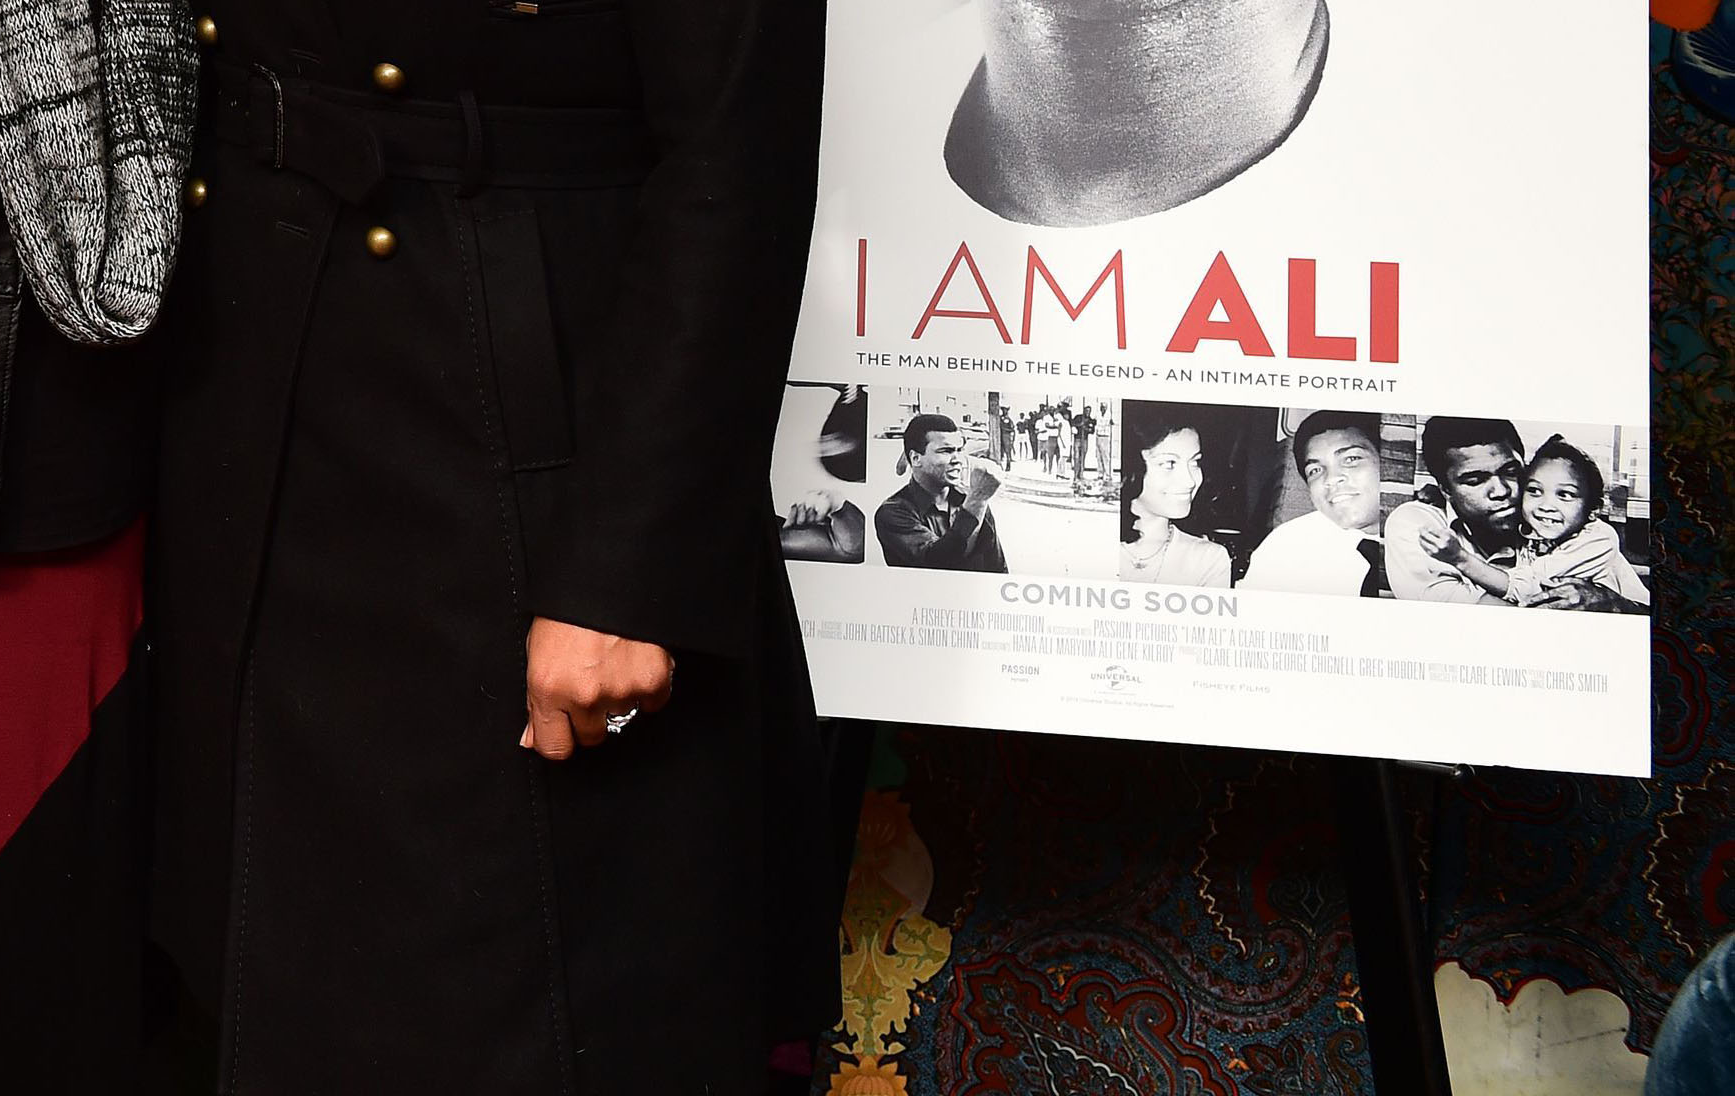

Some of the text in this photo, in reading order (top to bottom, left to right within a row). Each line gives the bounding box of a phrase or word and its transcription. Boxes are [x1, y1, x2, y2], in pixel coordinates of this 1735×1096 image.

[856, 238, 1399, 363] I AM ALI
[856, 352, 893, 368] THE
[898, 354, 940, 371] MAN
[947, 357, 1018, 375] BEHIND
[1025, 360, 1061, 377] THE
[1068, 363, 1145, 380] LEGEND
[1166, 367, 1193, 382] AN
[1200, 369, 1291, 388] INTIMATE
[1298, 375, 1399, 393] PORTRAIT
[1000, 581, 1238, 618] COMING SOON
[912, 607, 919, 625] A
[920, 607, 955, 629] FISHEYE
[958, 610, 985, 630] FILMS
[988, 611, 1044, 634] PRODUCTION
[1094, 618, 1131, 641] PASSION
[1135, 621, 1178, 643] PICTURES
[1190, 626, 1206, 645] AM
[1229, 629, 1236, 646] A
[1238, 629, 1266, 650] CLARE
[1269, 631, 1304, 652] LEWINS
[1307, 634, 1329, 653] FILM
[843, 622, 867, 642] JOHN
[870, 624, 906, 645] BATTSEK
[909, 628, 915, 644] &
[918, 627, 948, 647] SIMON
[951, 630, 979, 649] CHINN
[1012, 634, 1037, 654] HANA
[1038, 636, 1052, 655] ALI
[1056, 638, 1096, 658] MARYUM
[1098, 641, 1113, 659] ALI
[1115, 642, 1138, 661] GENE
[1142, 643, 1175, 664] KILROY
[1203, 647, 1230, 668] CLARE
[1234, 649, 1269, 670] LEWINS
[1272, 651, 1307, 673] GEORGE
[1311, 654, 1355, 677] CHIGNELL
[1359, 656, 1384, 678] GREG
[1459, 664, 1488, 686] CLARE
[1491, 667, 1527, 688] LEWINS
[1546, 670, 1574, 692] CHRIS
[1578, 673, 1608, 694] SMITH
[1001, 663, 1040, 676] PASSION
[1090, 672, 1142, 684] UNIVERSAL
